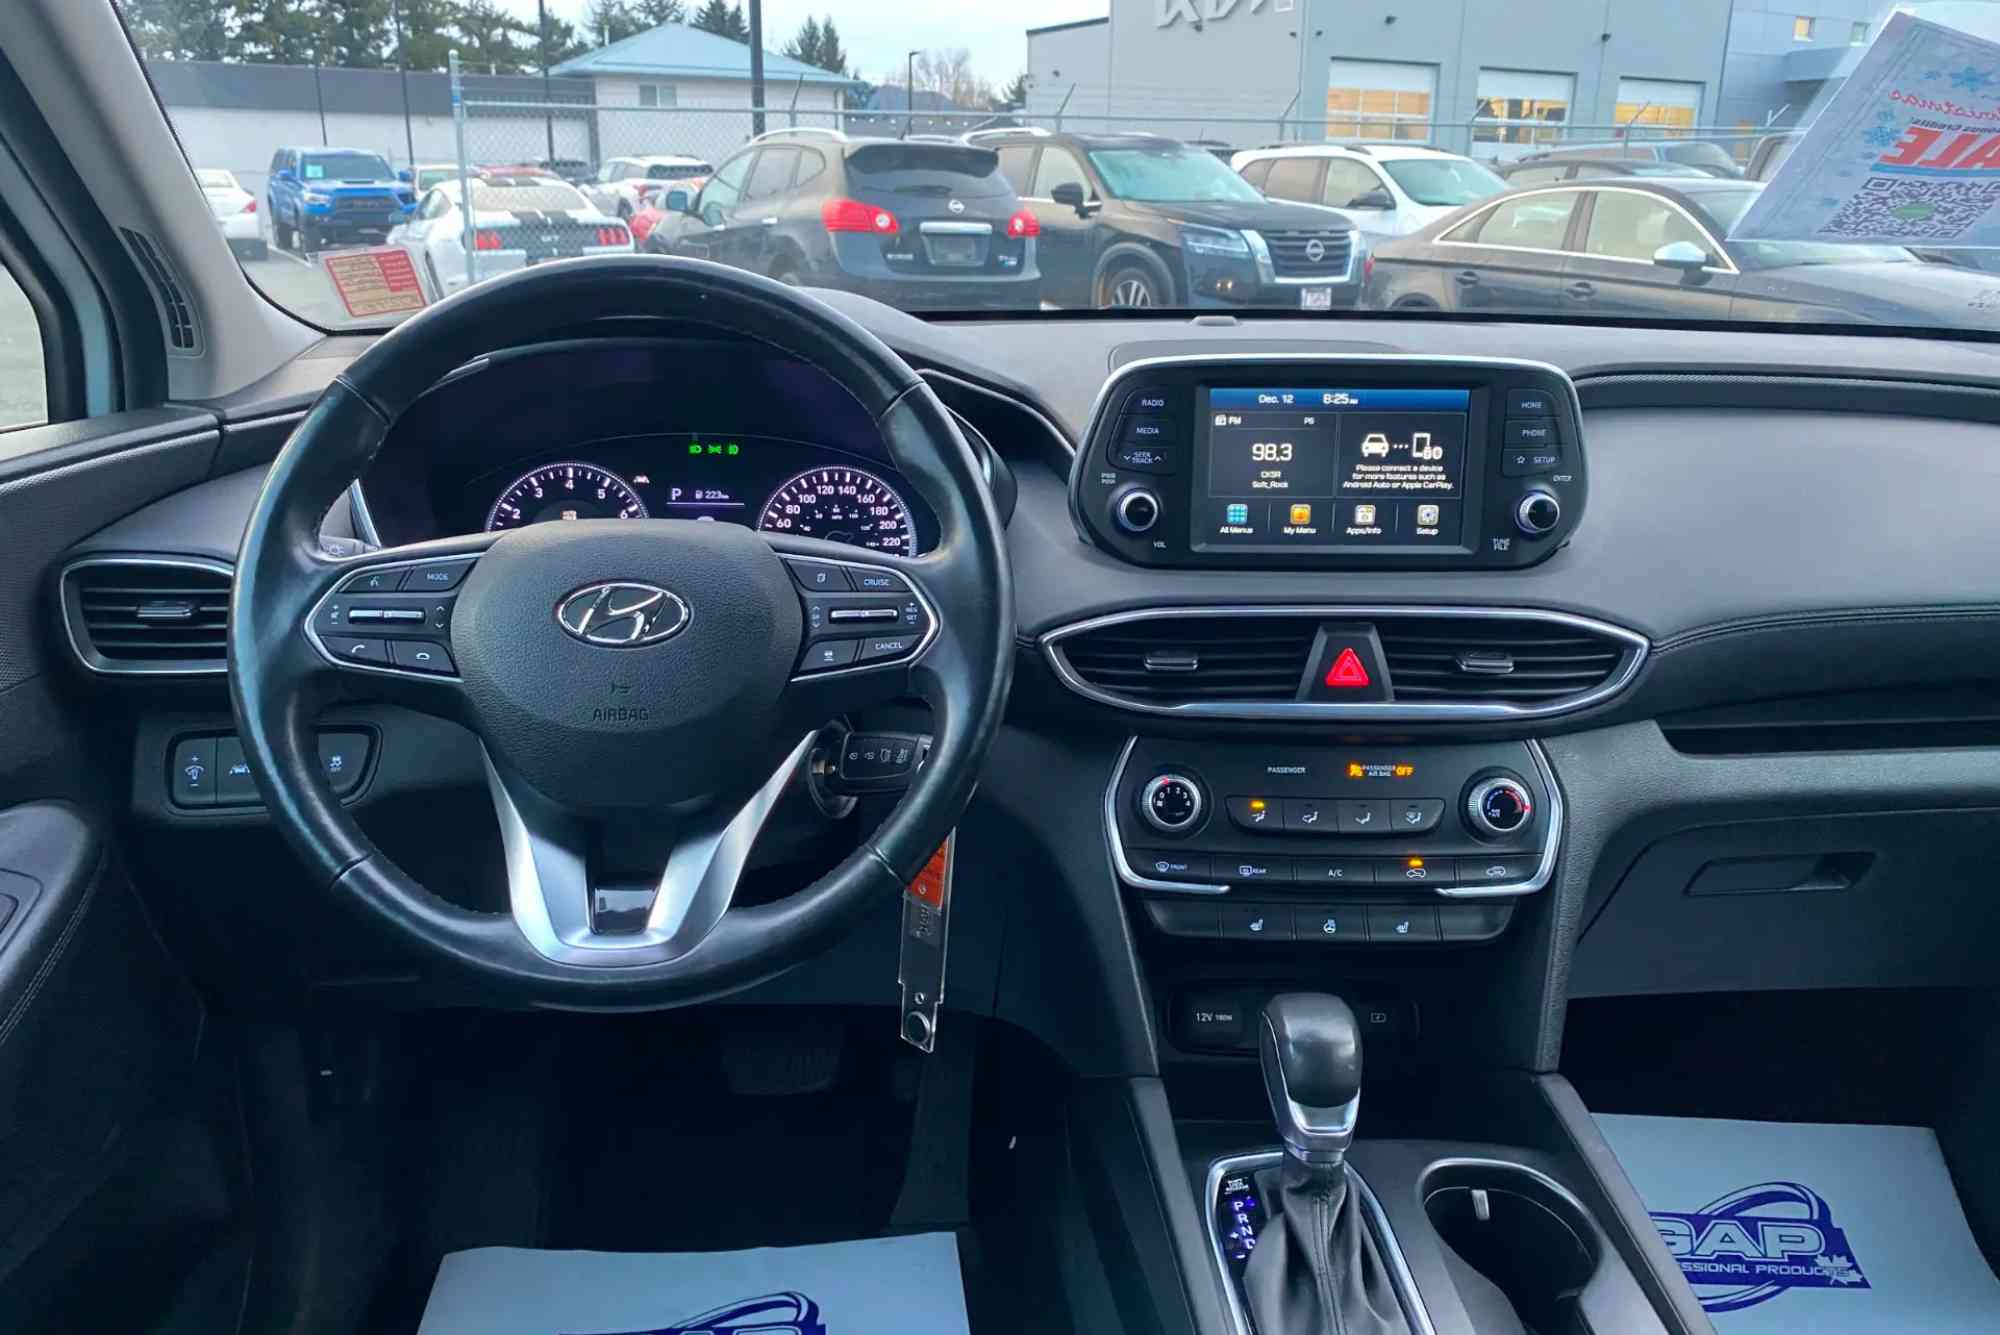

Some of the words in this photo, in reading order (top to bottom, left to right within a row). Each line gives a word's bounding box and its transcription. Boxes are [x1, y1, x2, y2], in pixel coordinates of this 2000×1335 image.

[1141, 399, 1165, 407] RADIO
[1282, 394, 1294, 404] 12
[1522, 429, 1546, 437] PHONE
[1252, 443, 1293, 462] 98.3
[1355, 464, 1380, 472] Please
[1381, 464, 1412, 472] connect
[1419, 464, 1444, 472] device
[565, 479, 574, 490] 4
[1343, 481, 1372, 489] Android
[1373, 481, 1391, 489] Auto
[1401, 481, 1423, 490] Apple
[535, 487, 543, 498] 3
[598, 488, 606, 499] 5
[671, 488, 682, 500] P
[817, 486, 835, 495] 120
[838, 486, 857, 496] 140
[798, 494, 816, 504] 100
[857, 494, 876, 504] 160
[512, 508, 521, 519] 2
[620, 509, 628, 519] 6
[786, 505, 800, 515] 80
[870, 506, 889, 516] 180
[776, 519, 792, 529] 60
[879, 521, 897, 530] 200
[1283, 527, 1295, 535] My
[1295, 527, 1316, 535] Menu
[1416, 527, 1439, 536] Setup
[883, 537, 901, 547] 220
[1153, 541, 1167, 549] VOL
[427, 573, 449, 581] MODE
[863, 578, 890, 586] CRUISE
[875, 641, 903, 650] CANCEL
[592, 708, 649, 721] AIRBAG
[1267, 766, 1306, 774] PASSENGER
[1396, 766, 1414, 776] OFF
[1159, 791, 1165, 799] 0
[1182, 791, 1188, 799] 3
[1328, 869, 1343, 877] A/C
[1196, 1012, 1214, 1022] 12V
[1233, 1201, 1244, 1211] P
[1238, 1213, 1249, 1224] R
[1240, 1225, 1253, 1236] N
[1680, 1261, 1750, 1274] SSIONAL
